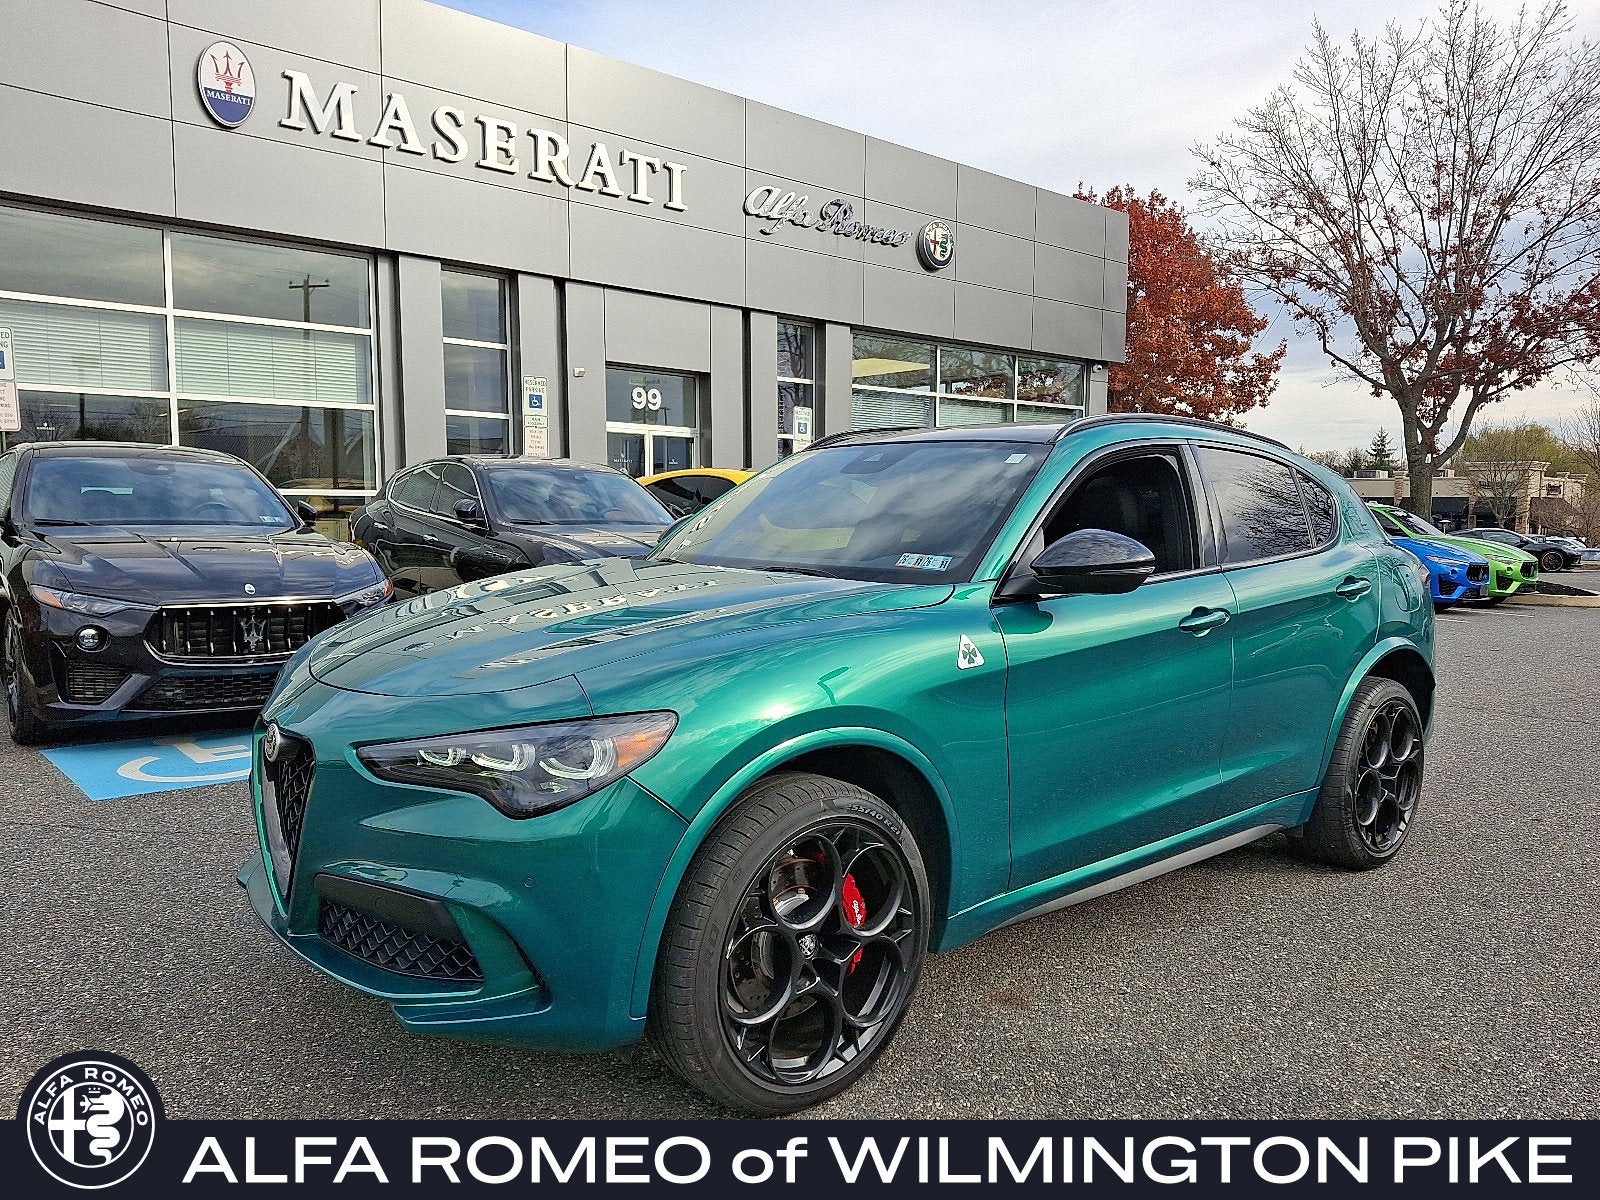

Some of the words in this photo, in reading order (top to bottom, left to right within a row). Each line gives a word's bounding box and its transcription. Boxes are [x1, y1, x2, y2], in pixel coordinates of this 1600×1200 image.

[207, 89, 251, 106] MASERATI
[277, 69, 688, 212] MASERATI
[743, 185, 815, 235] Alfa
[818, 198, 912, 248] Romeo
[631, 386, 662, 411] 99
